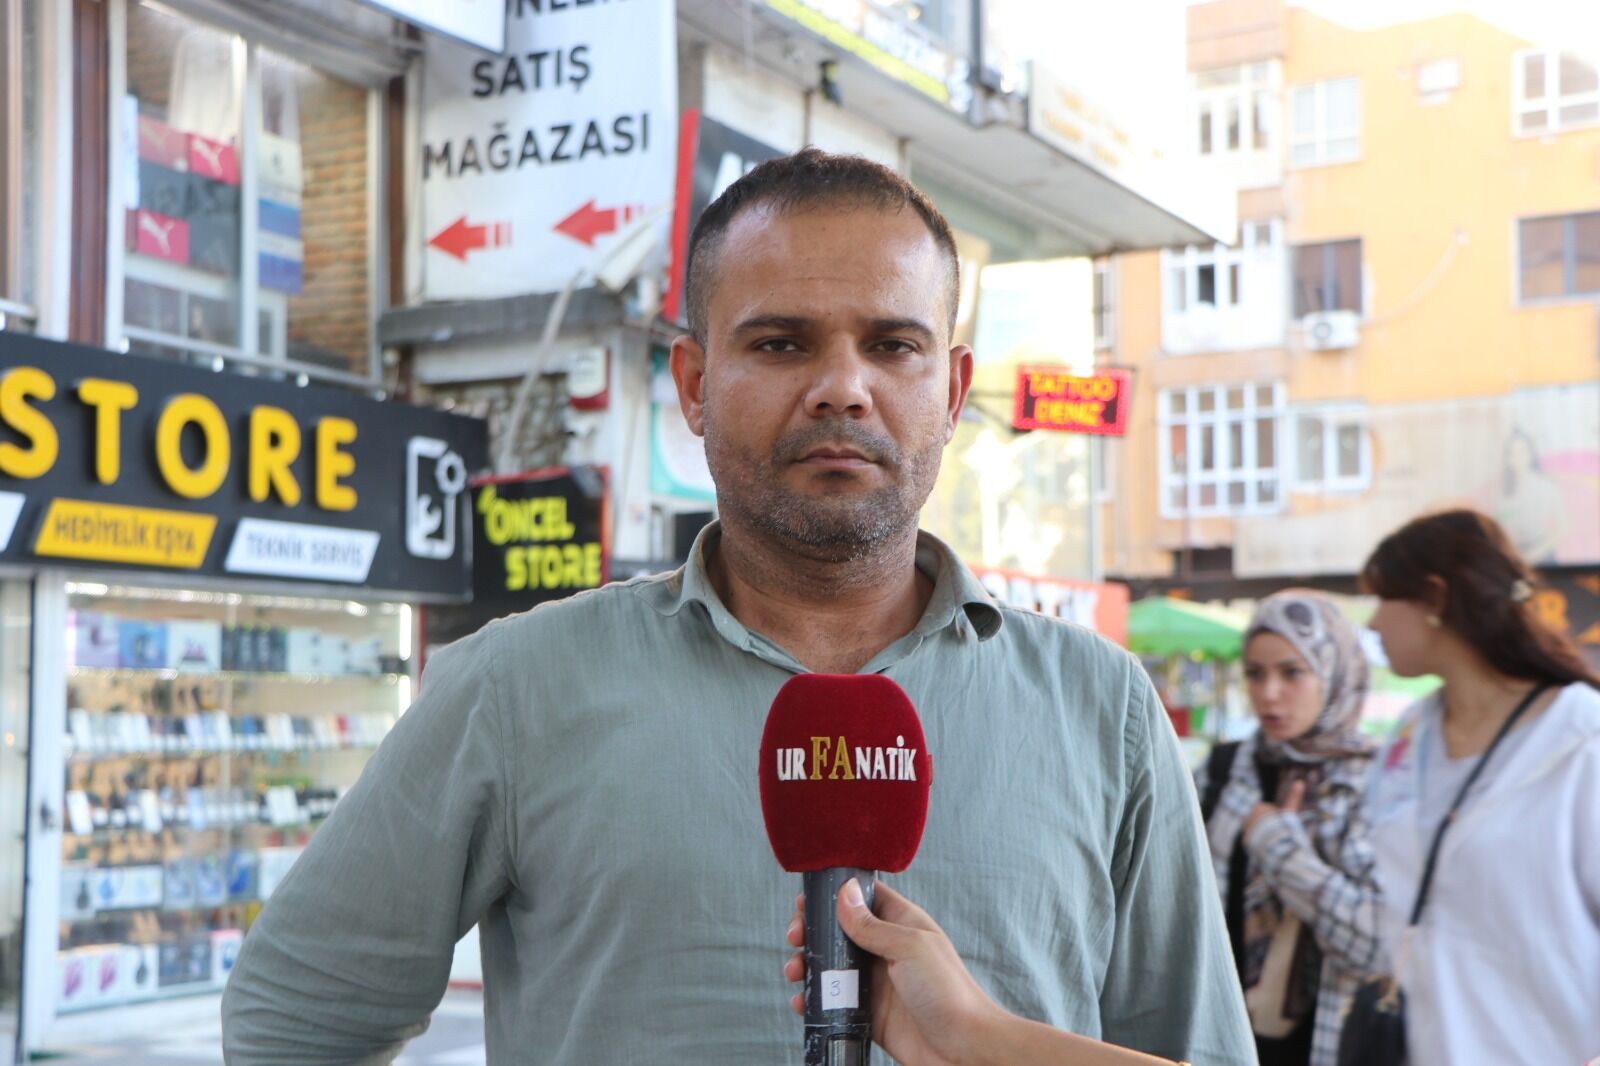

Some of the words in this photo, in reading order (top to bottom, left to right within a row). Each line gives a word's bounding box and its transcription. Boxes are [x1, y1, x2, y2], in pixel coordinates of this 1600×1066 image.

[473, 45, 591, 98] SATIŞ
[423, 112, 650, 180] MAĞAZASI
[0, 366, 358, 511] STORE
[505, 542, 602, 591] STORE
[830, 979, 841, 997] 3
